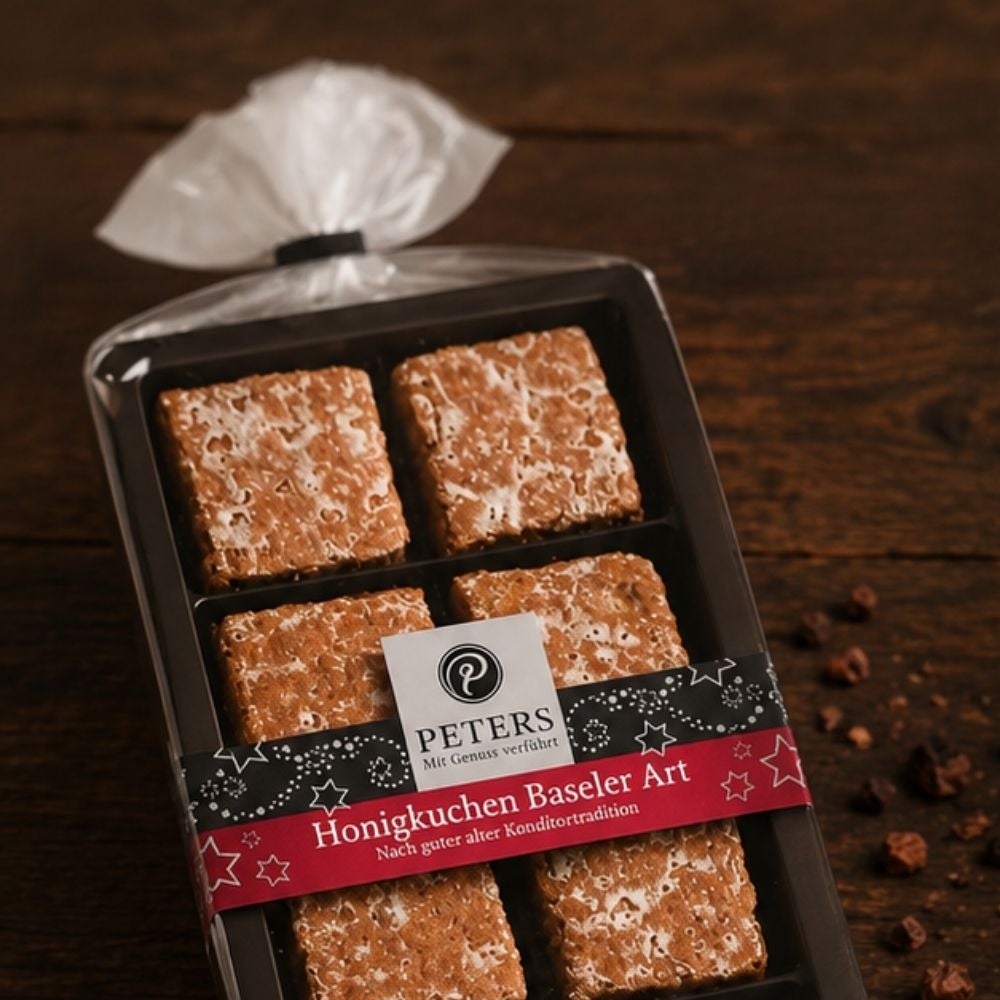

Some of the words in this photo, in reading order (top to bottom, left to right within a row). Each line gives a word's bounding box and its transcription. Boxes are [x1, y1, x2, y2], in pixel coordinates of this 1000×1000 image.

[416, 707, 556, 753] PETERS
[422, 754, 447, 770] Mit
[450, 747, 499, 765] Genuss
[502, 737, 560, 756] verführt
[312, 794, 520, 849] Honigkuchen
[524, 770, 633, 810] Baseler
[642, 759, 691, 790] Art
[376, 843, 417, 860] Nach
[421, 835, 462, 856] guter
[466, 827, 501, 845] alter
[504, 801, 640, 838] Konditortradition
